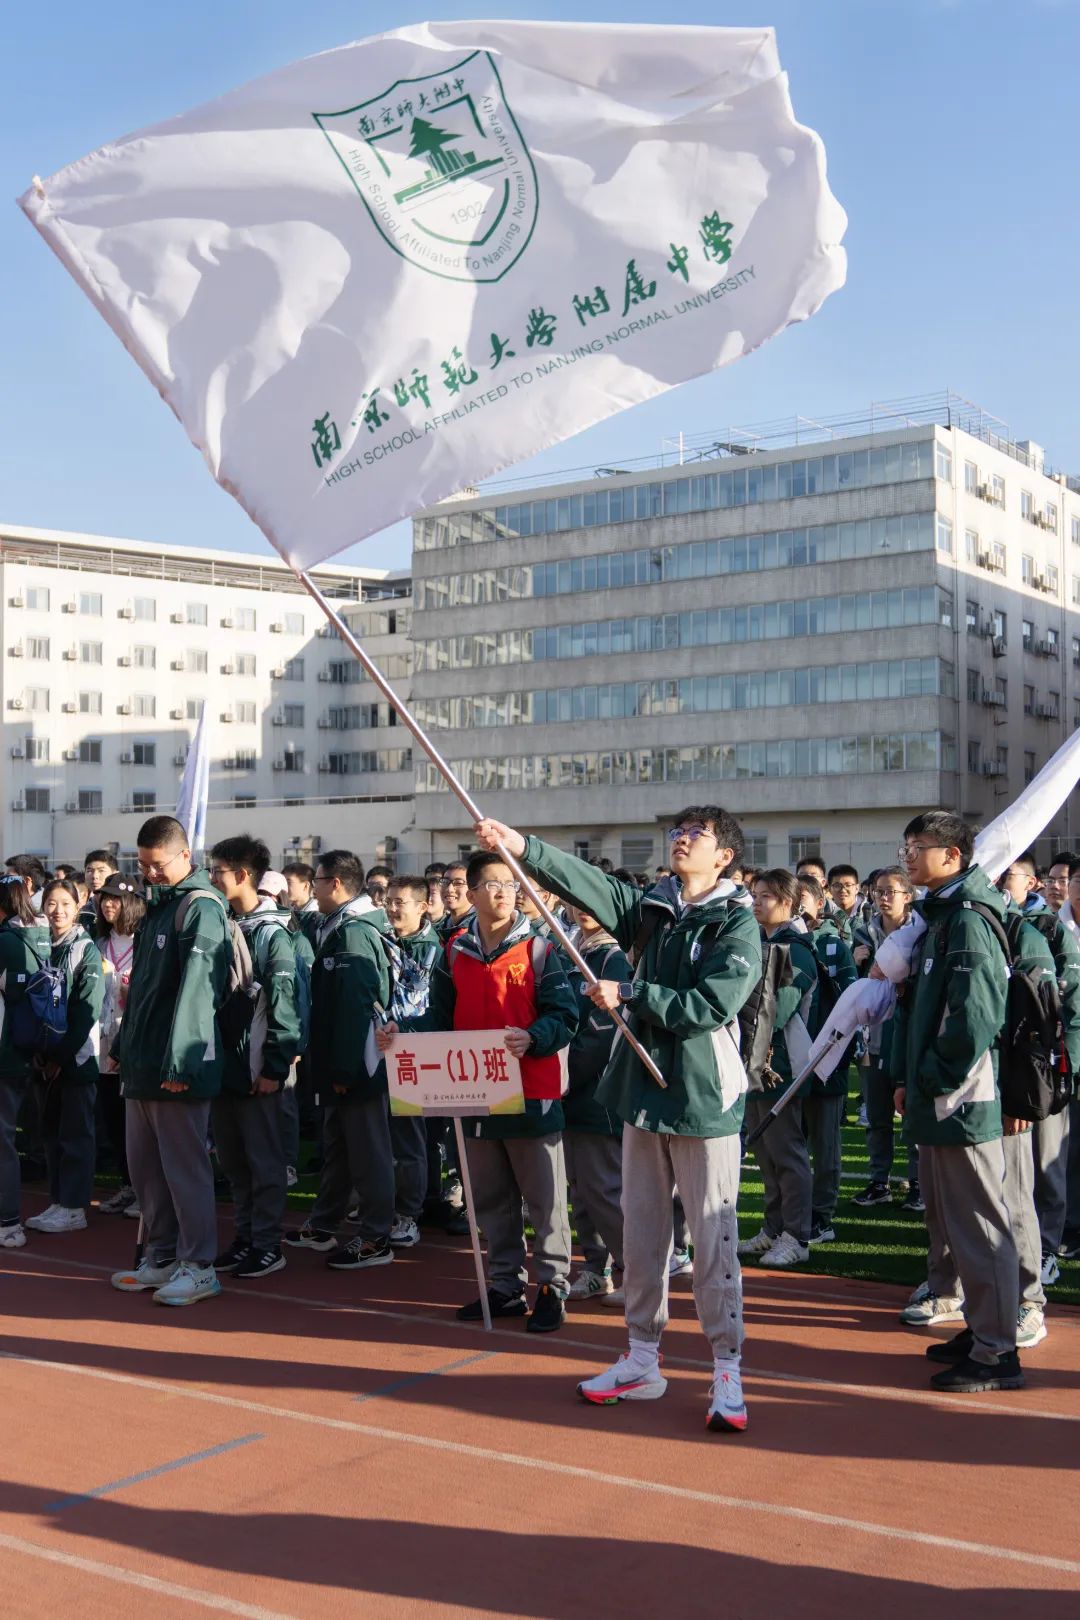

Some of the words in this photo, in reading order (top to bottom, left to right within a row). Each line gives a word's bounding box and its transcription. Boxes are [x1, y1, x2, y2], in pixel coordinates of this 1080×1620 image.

[482, 95, 519, 167] University
[348, 149, 371, 181] High
[369, 183, 401, 233] School
[451, 201, 487, 225] 1902
[512, 170, 526, 219] Normal
[400, 232, 461, 268] Affiliated
[464, 256, 480, 270] To
[482, 222, 521, 268] Nanjing
[324, 458, 363, 487] HIGH
[363, 428, 422, 465] SCHOOL
[424, 384, 509, 434] AFFILIATED
[510, 371, 533, 389] TO
[535, 338, 604, 378] NANJING
[605, 309, 673, 346] NORMAL
[674, 264, 757, 315] UNIVERSITY
[395, 1047, 510, 1086] 高一(1)班
